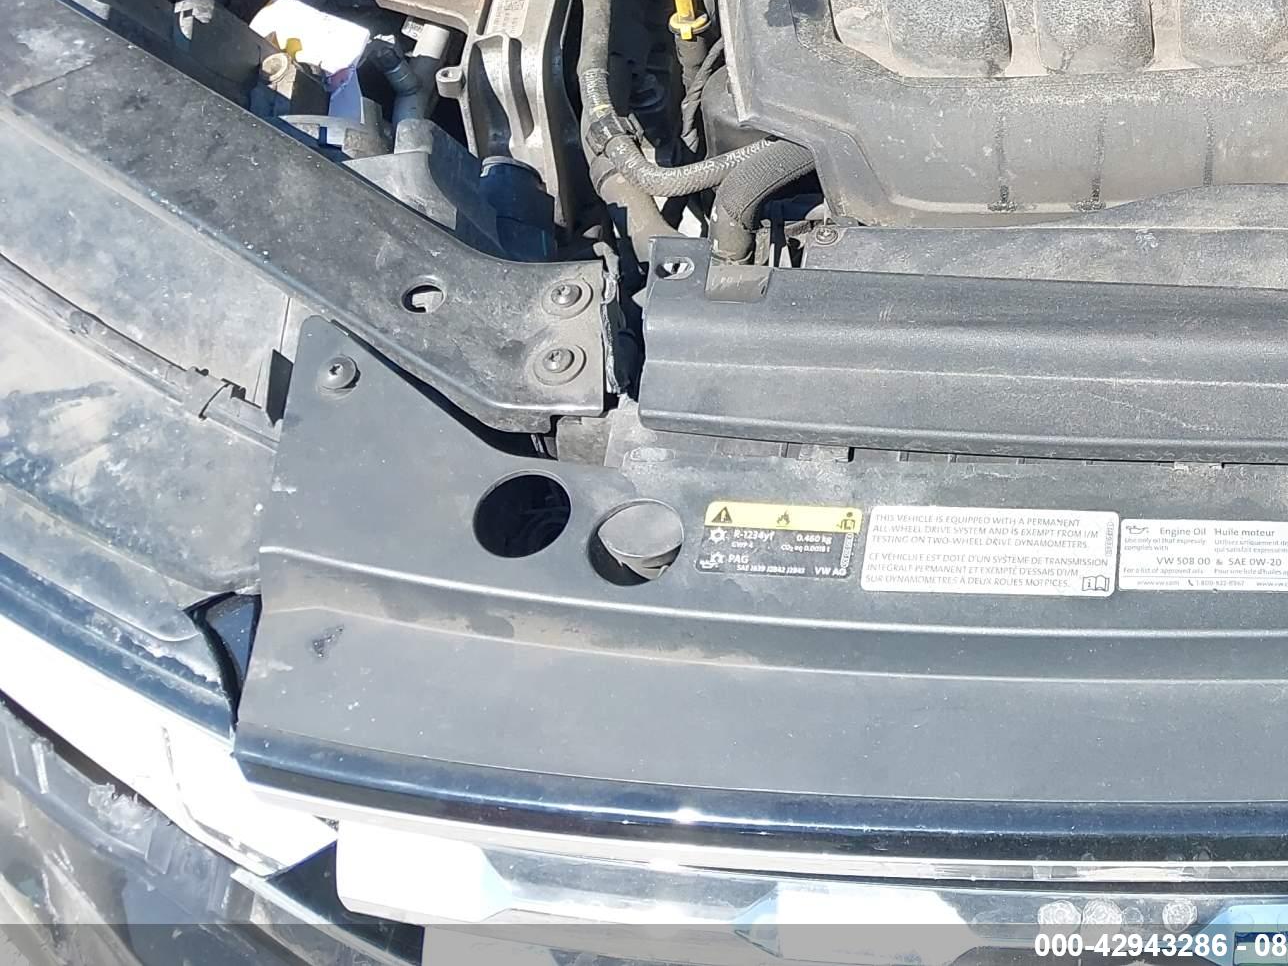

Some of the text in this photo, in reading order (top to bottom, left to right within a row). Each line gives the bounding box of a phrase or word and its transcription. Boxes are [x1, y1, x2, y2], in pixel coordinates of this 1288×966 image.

[876, 514, 895, 522] THIS
[897, 514, 933, 523] VEHICLE
[936, 515, 943, 523] IS
[945, 515, 990, 525] EQUIPPED
[992, 517, 1016, 525] WITH
[1027, 518, 1080, 527] PERMANENT
[734, 529, 775, 542] R-1234yf
[924, 526, 951, 534] DRIVE
[953, 526, 986, 535] SYSTEM
[988, 527, 1009, 536] AND
[1011, 528, 1018, 536] IS
[1021, 528, 1054, 537] EXEMPT
[1057, 529, 1082, 538] FROM
[1160, 527, 1206, 538] Engine Oil
[1214, 528, 1275, 537] Huile moteur
[821, 534, 832, 545] kg
[872, 535, 909, 544] TESTING
[910, 536, 925, 544] ON
[928, 536, 984, 546] TWO-WHEEL
[985, 537, 1011, 546] DRIVE
[728, 553, 749, 563] PAG
[869, 553, 879, 561] CE
[926, 554, 941, 562] EST
[968, 554, 990, 563] D'UN
[1031, 557, 1042, 565] DE
[1045, 557, 1109, 567] TRANSMISSION
[1156, 556, 1174, 565] VW
[1176, 556, 1195, 565] 508
[1197, 556, 1211, 566] 00
[1228, 557, 1246, 566] SAE
[1249, 557, 1282, 567] 0W-20
[814, 566, 847, 576] VW AG
[968, 566, 978, 574] ET
[1019, 567, 1055, 576] D'ESSAIS
[865, 574, 883, 583] SUR
[968, 576, 991, 586] DEUX
[994, 577, 1023, 586] ROUES
